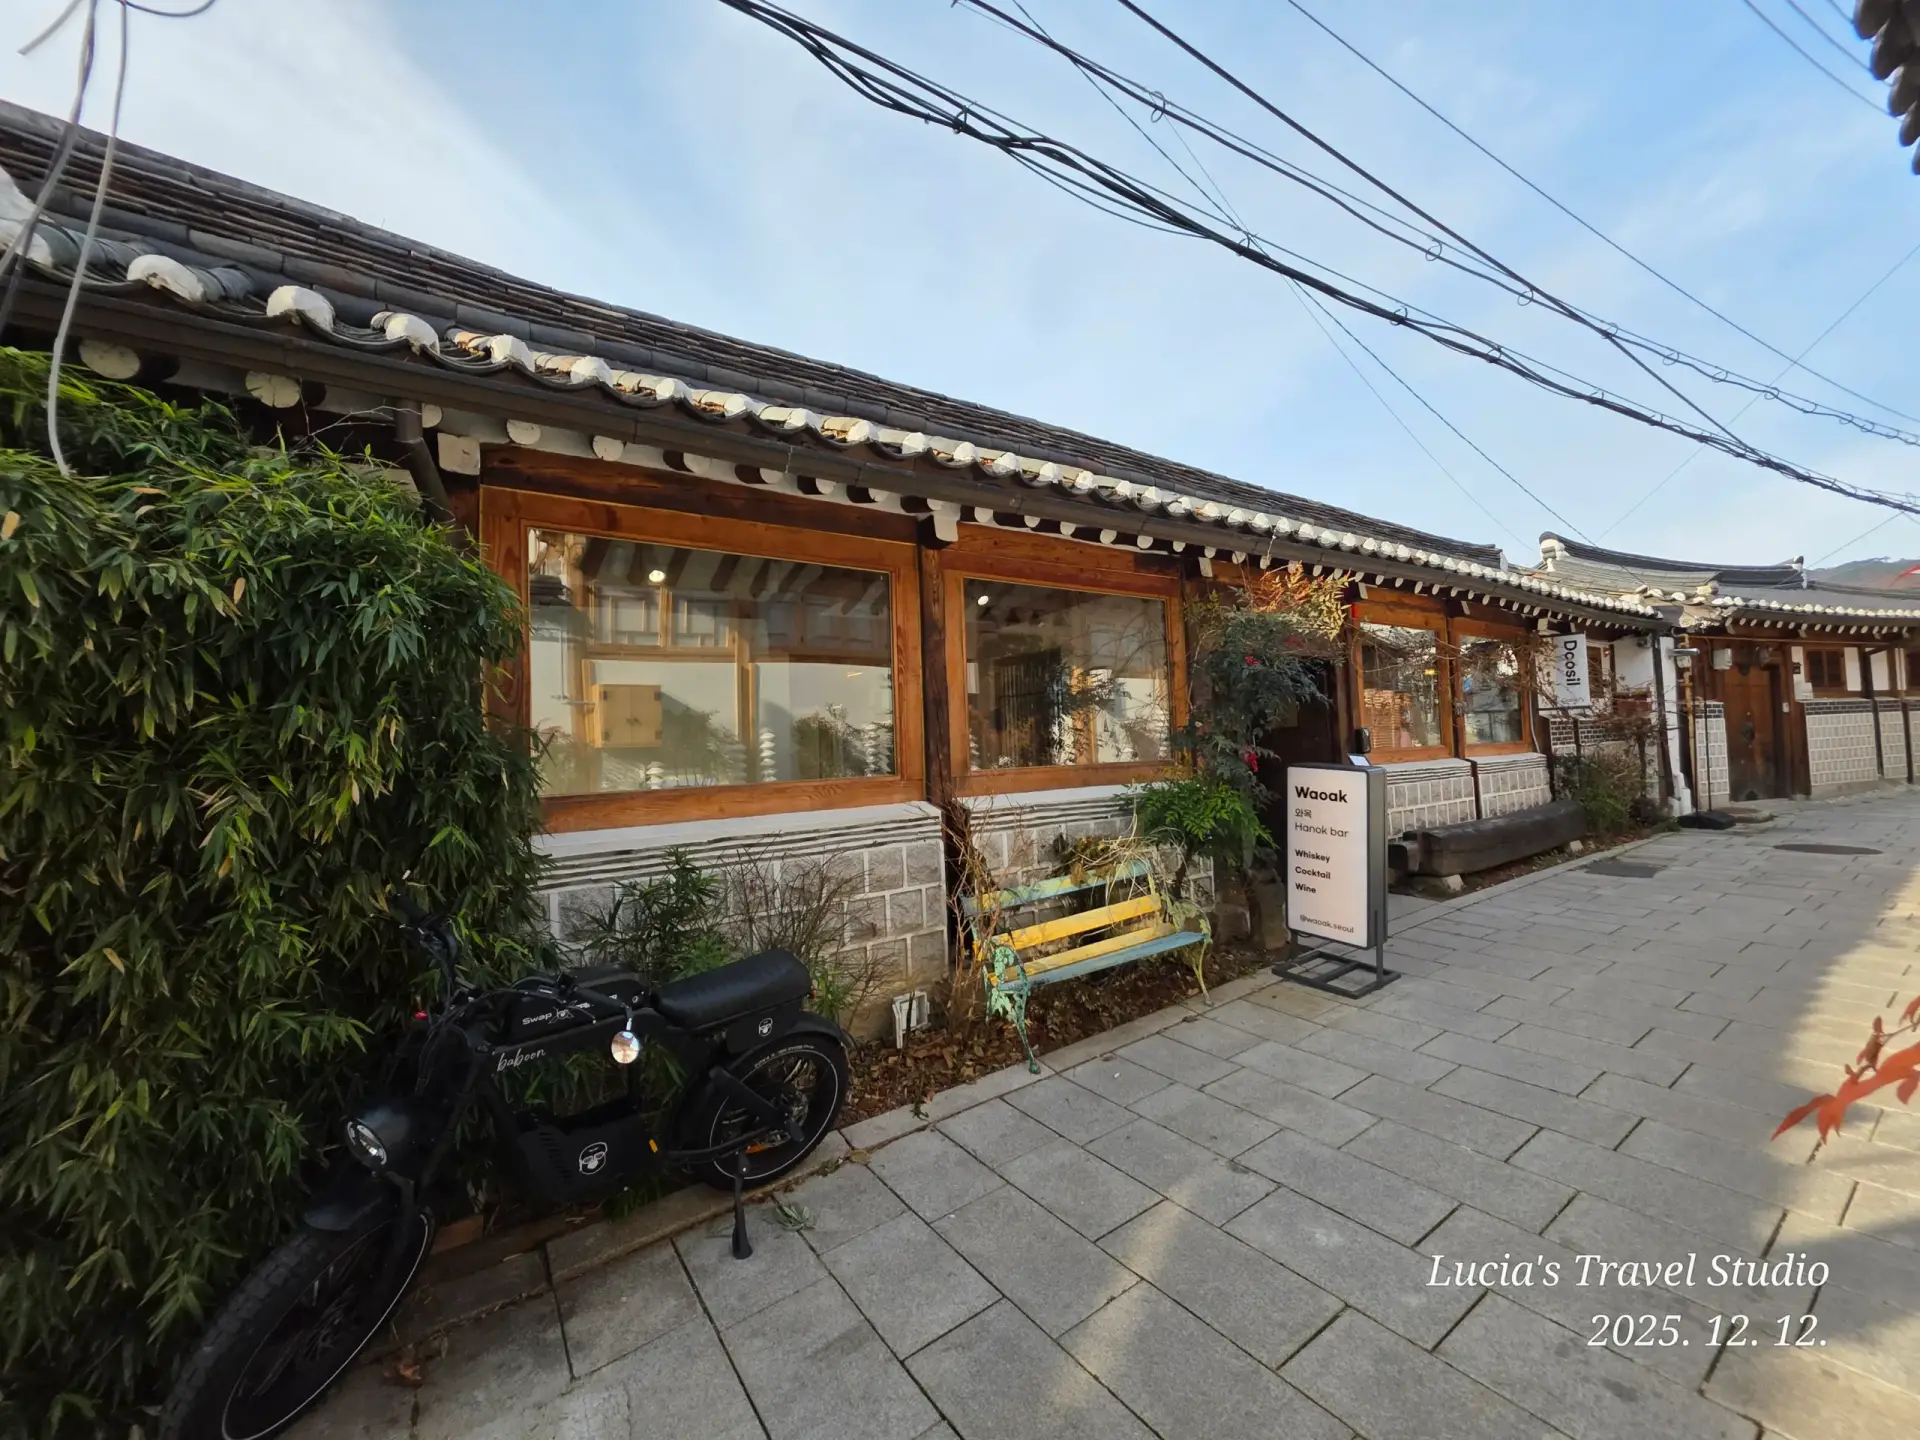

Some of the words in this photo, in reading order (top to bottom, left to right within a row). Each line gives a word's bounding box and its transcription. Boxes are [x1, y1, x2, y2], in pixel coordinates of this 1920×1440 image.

[1563, 640, 1581, 686] Dcosil
[1294, 785, 1348, 804] Waoak
[1294, 808, 1313, 819] 와옥
[1294, 821, 1328, 836] Hanok
[1330, 826, 1349, 838] bar
[1294, 848, 1331, 864] Whiskey
[1294, 865, 1331, 880] Cocktail
[1294, 882, 1317, 894] Wine
[1299, 914, 1354, 934] @waoak.seoul
[521, 1011, 553, 1026] Swap
[496, 1047, 547, 1072] baboon
